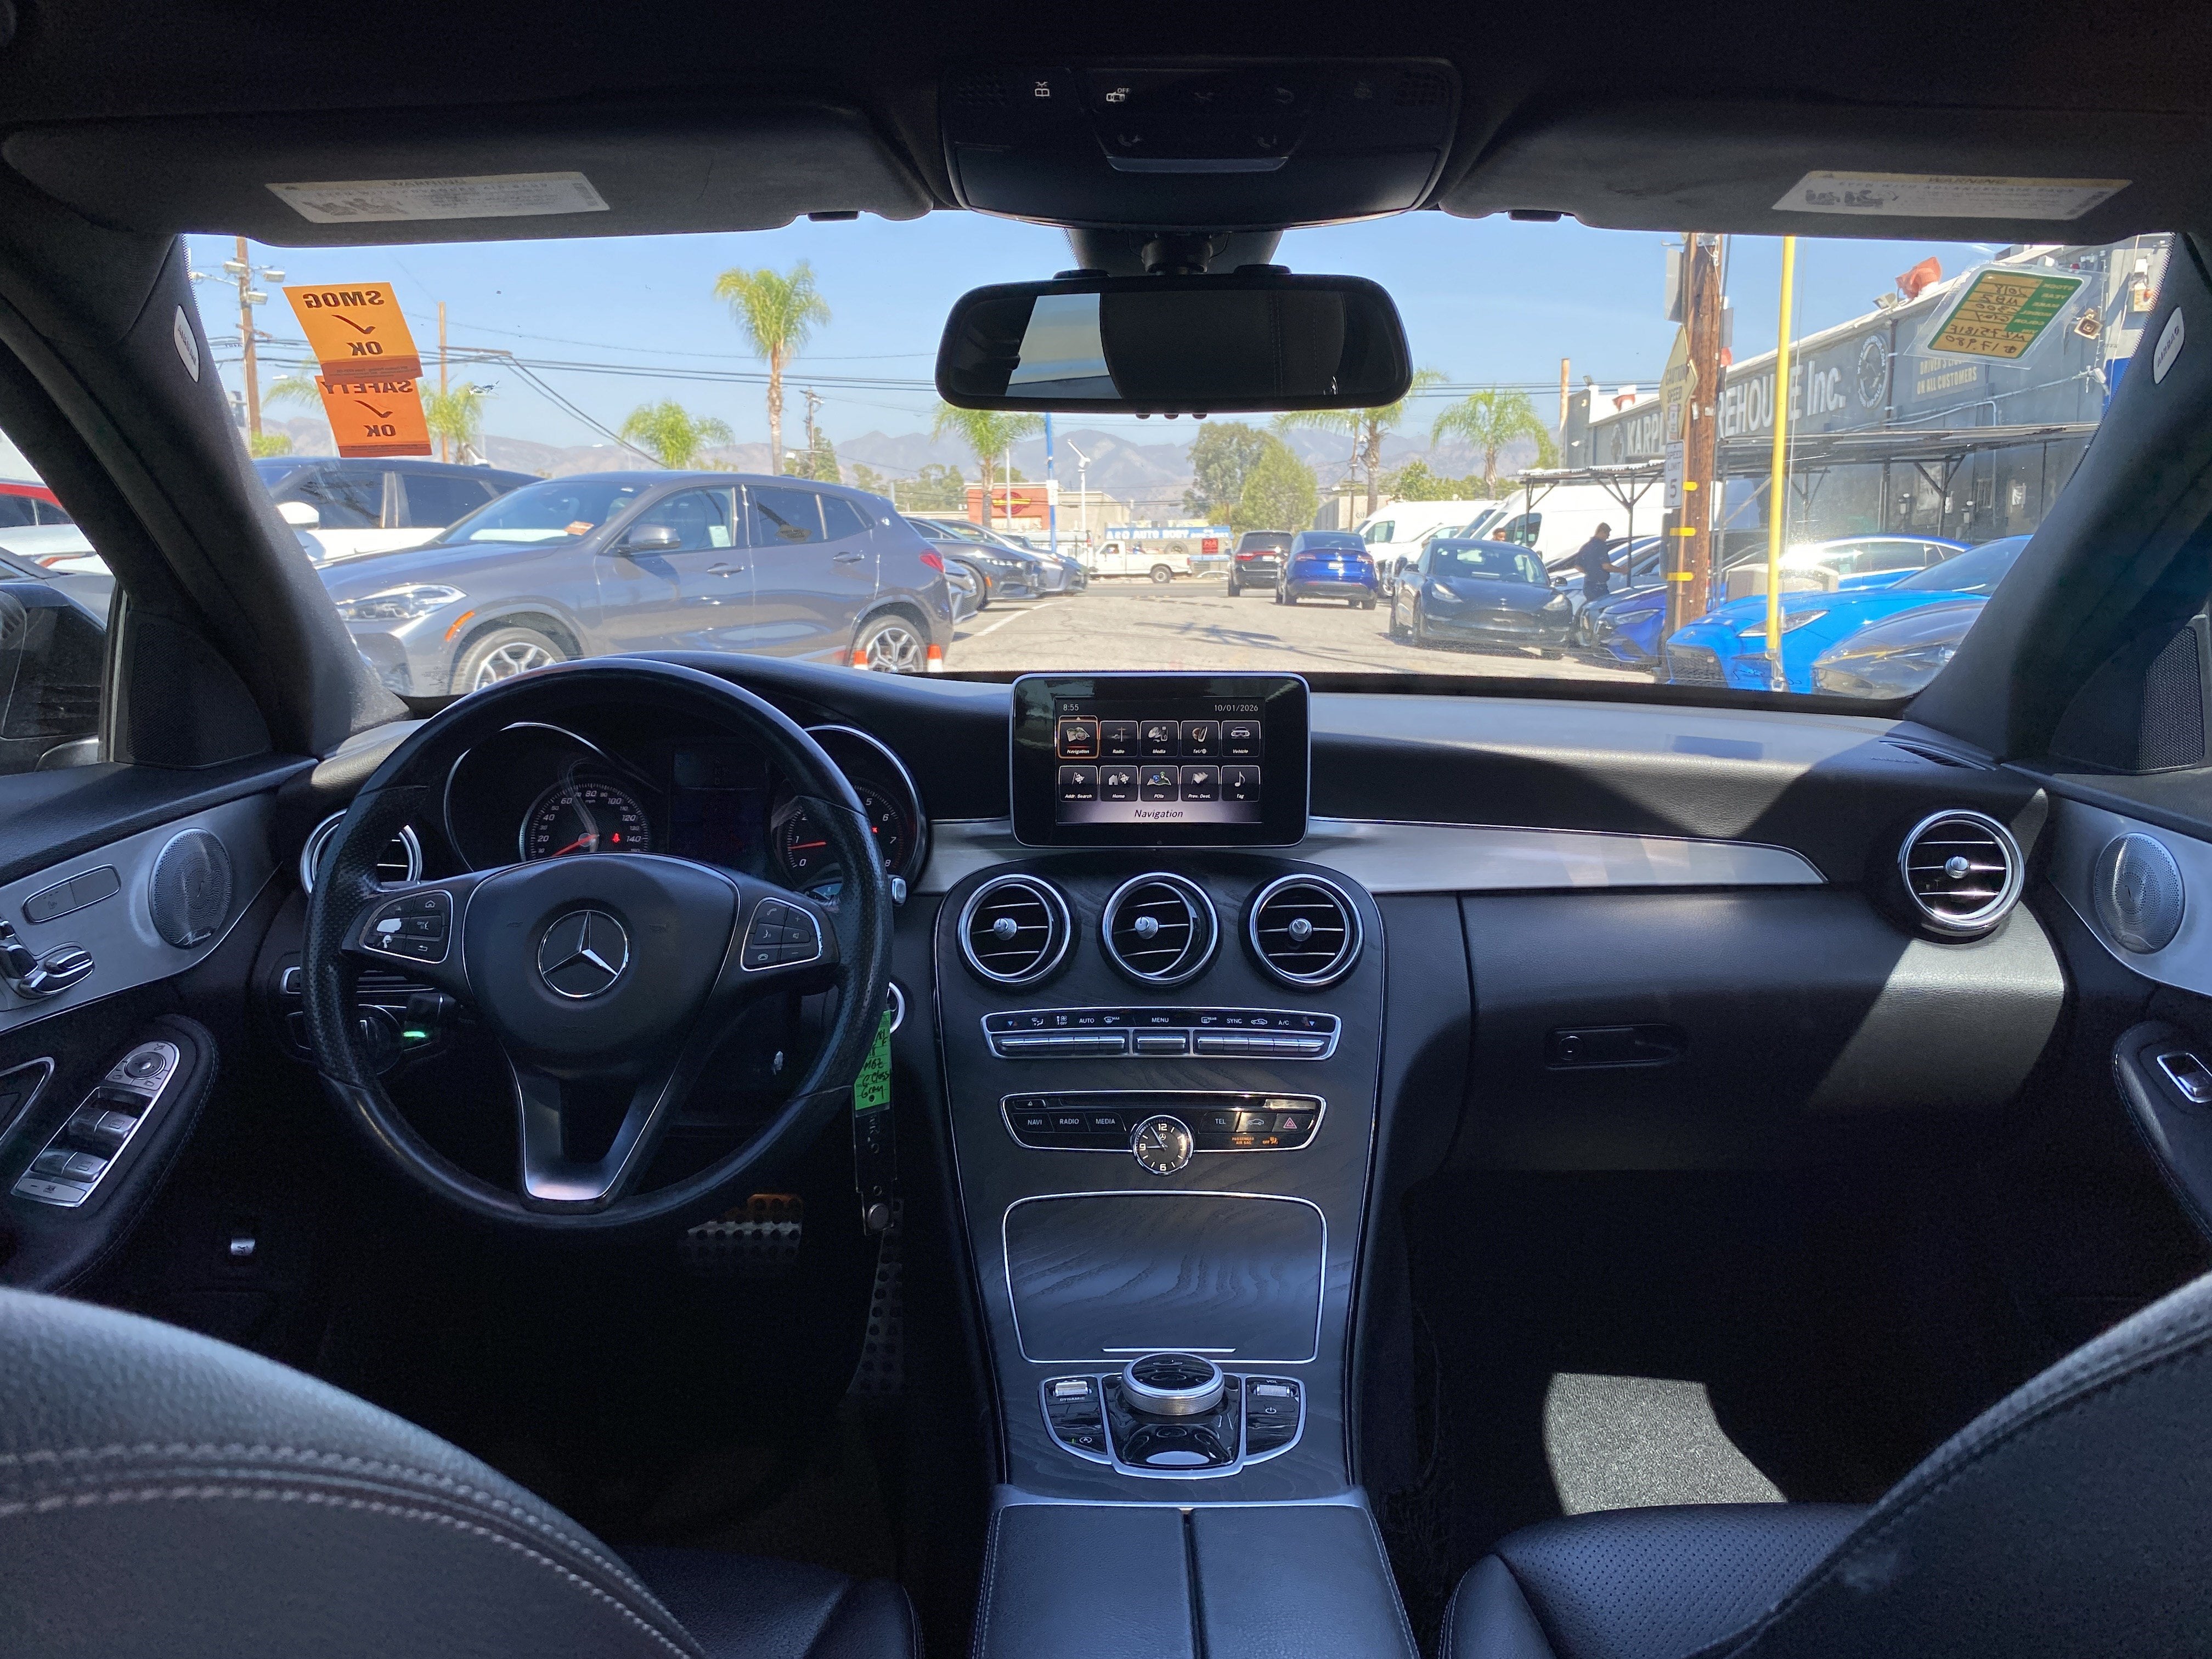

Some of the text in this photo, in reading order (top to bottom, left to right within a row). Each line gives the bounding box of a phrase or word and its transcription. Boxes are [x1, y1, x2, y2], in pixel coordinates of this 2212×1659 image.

[1917, 366, 1977, 395] ON ALL CUSTOMERS
[1807, 360, 1847, 416] Inc.
[1667, 450, 1682, 459] SPEED
[1670, 478, 1678, 499] 5
[1133, 530, 1160, 539] AUTO
[1214, 704, 1259, 712] 10/01/2026
[882, 814, 889, 822] 6
[1134, 809, 1183, 820] Navigation
[889, 836, 897, 844] 7
[799, 859, 807, 867] 0
[1158, 1123, 1167, 1131] 12
[1139, 1143, 1147, 1151] 9
[1159, 1163, 1167, 1171] 6
